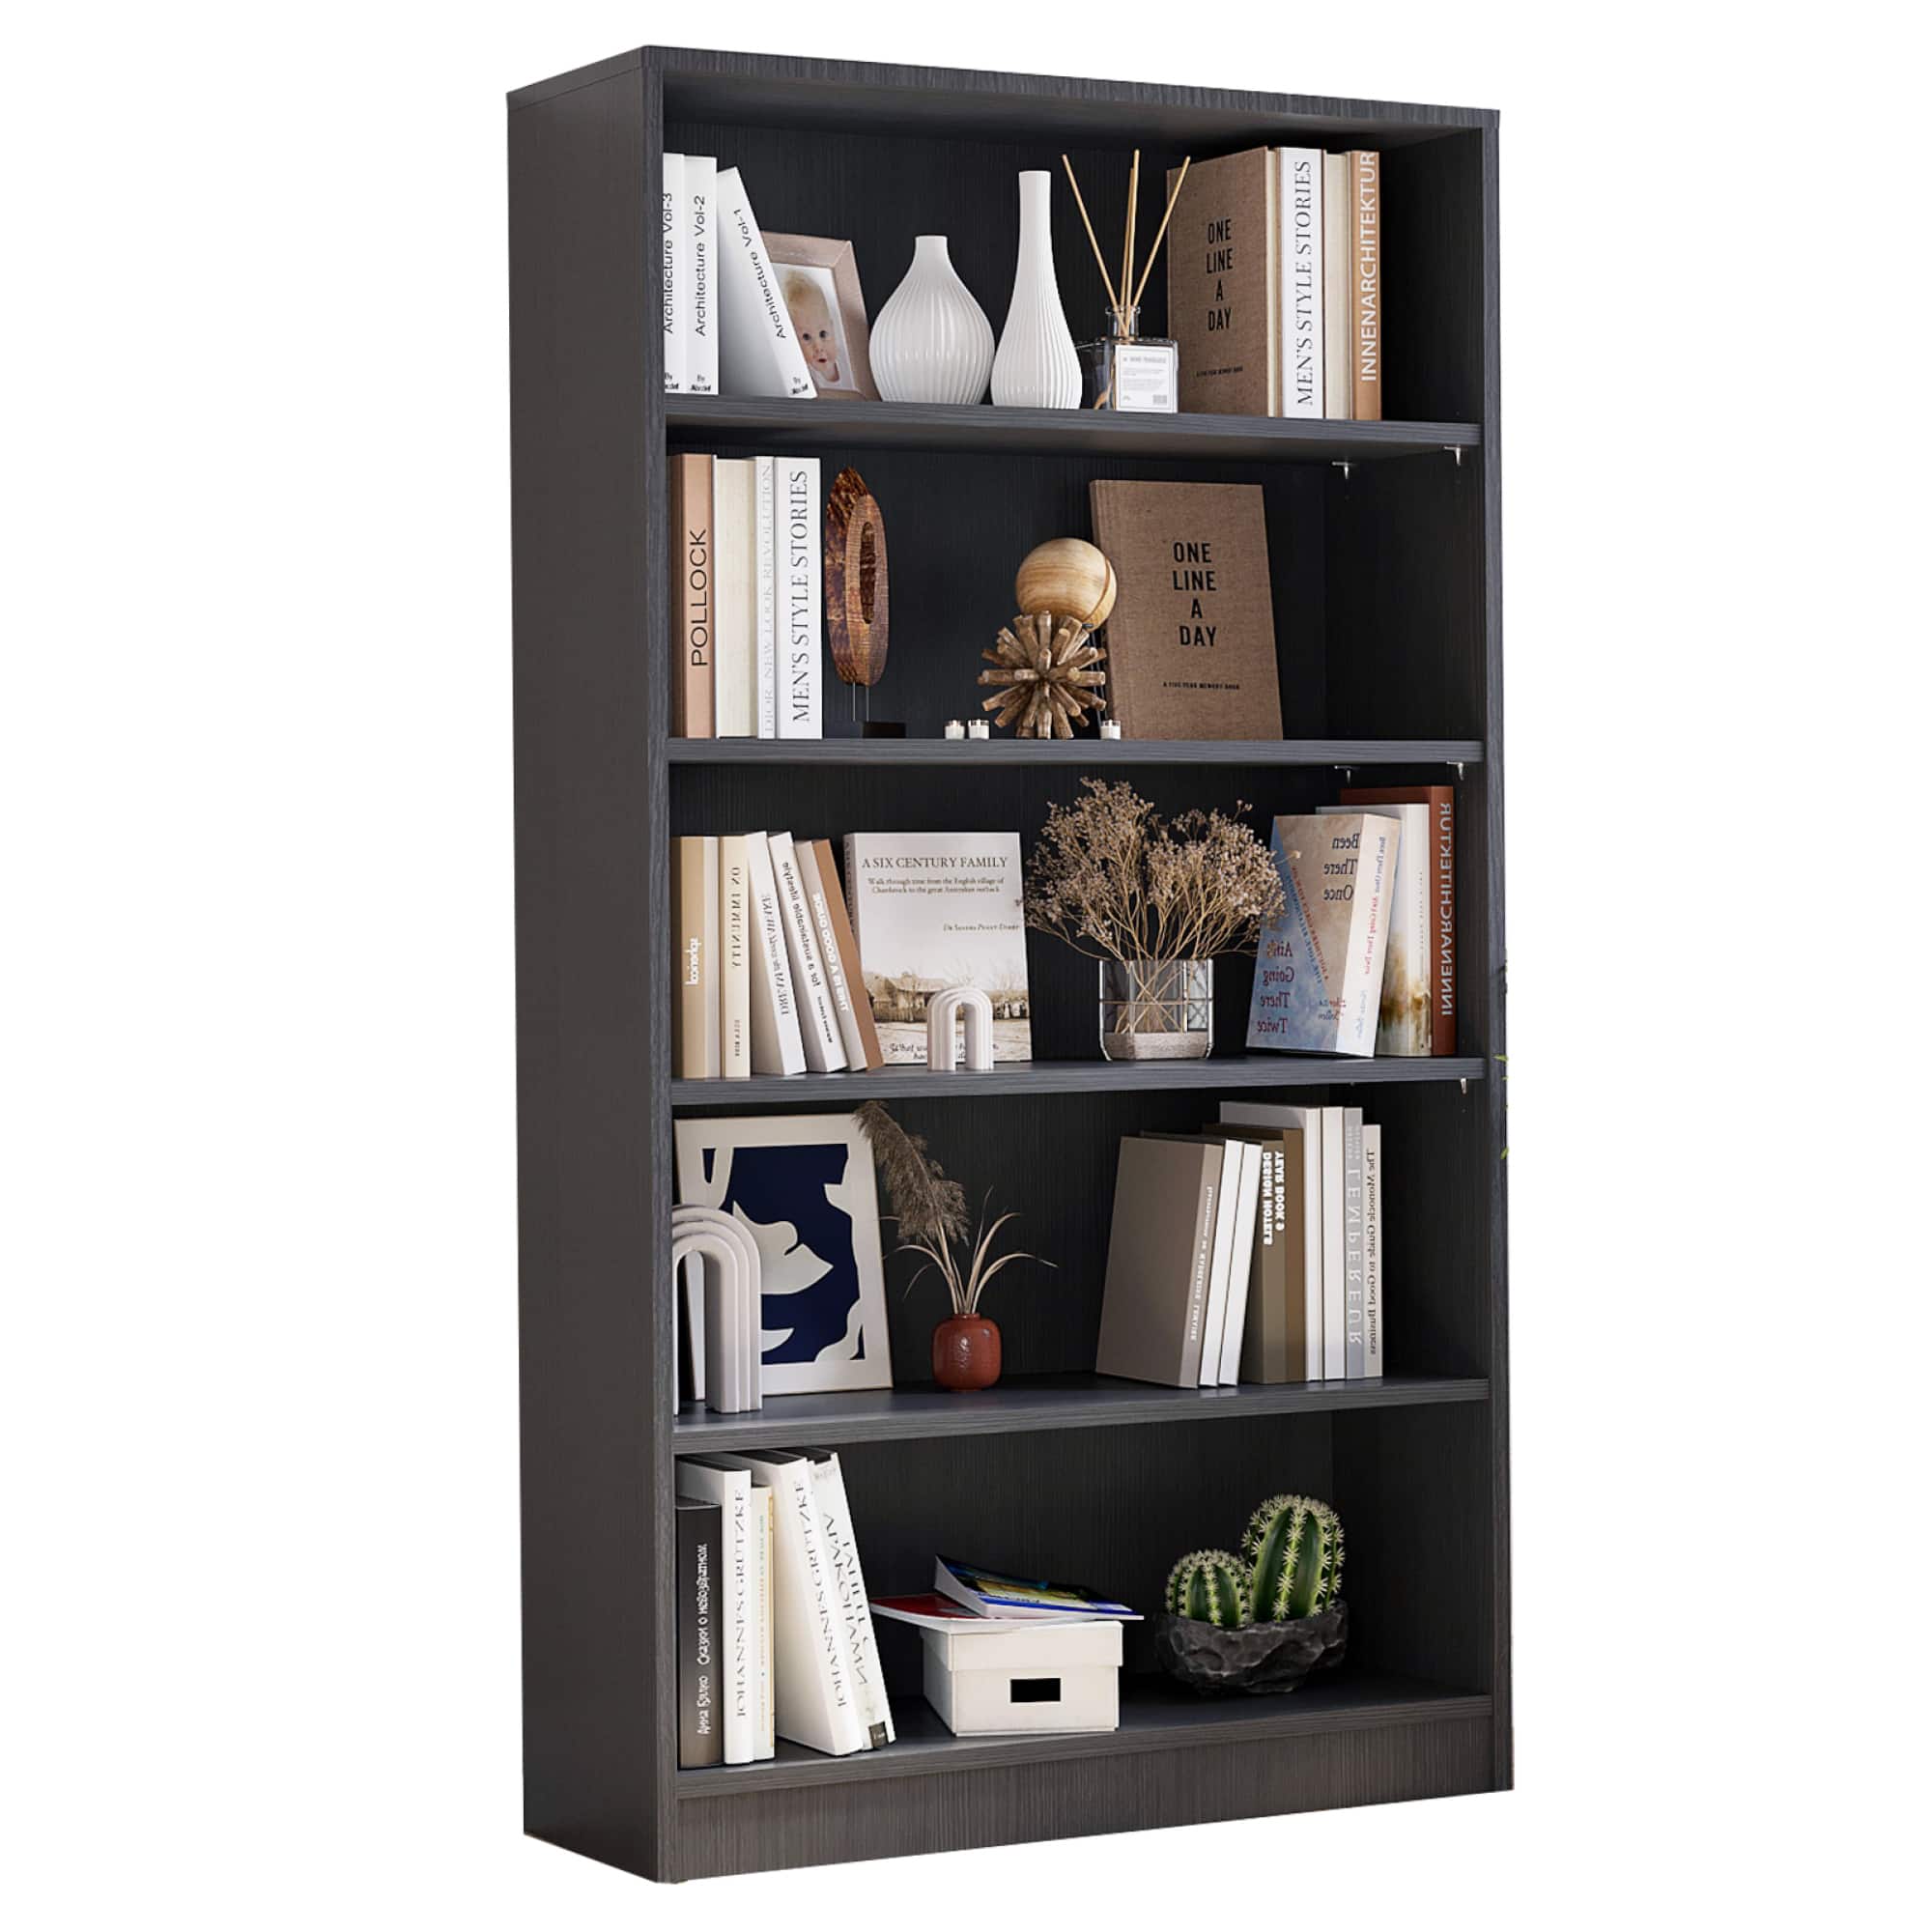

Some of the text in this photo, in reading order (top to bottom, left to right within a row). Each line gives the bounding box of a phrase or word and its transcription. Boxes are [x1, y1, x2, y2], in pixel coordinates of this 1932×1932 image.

[663, 193, 672, 233] Vol-3
[1208, 218, 1232, 245] ONE
[694, 195, 706, 337] Architecture Vol-2
[733, 209, 786, 339] Architecture Vol-1
[1206, 248, 1234, 274] LINE
[1359, 150, 1377, 382] INNENARCHITEKTUR
[1215, 279, 1224, 302] A
[1293, 160, 1314, 408] MEN'S STYLE STORIES
[1208, 307, 1232, 332] DAY
[1173, 542, 1211, 563] ONE
[1173, 570, 1217, 591] LINE
[689, 529, 708, 667] POLLOCK
[789, 470, 810, 724] MEN'S STYLE STORIES
[1191, 598, 1203, 619] A
[1179, 626, 1217, 646] DAY
[862, 856, 1009, 868] A SIX CENTURY FAMILY
